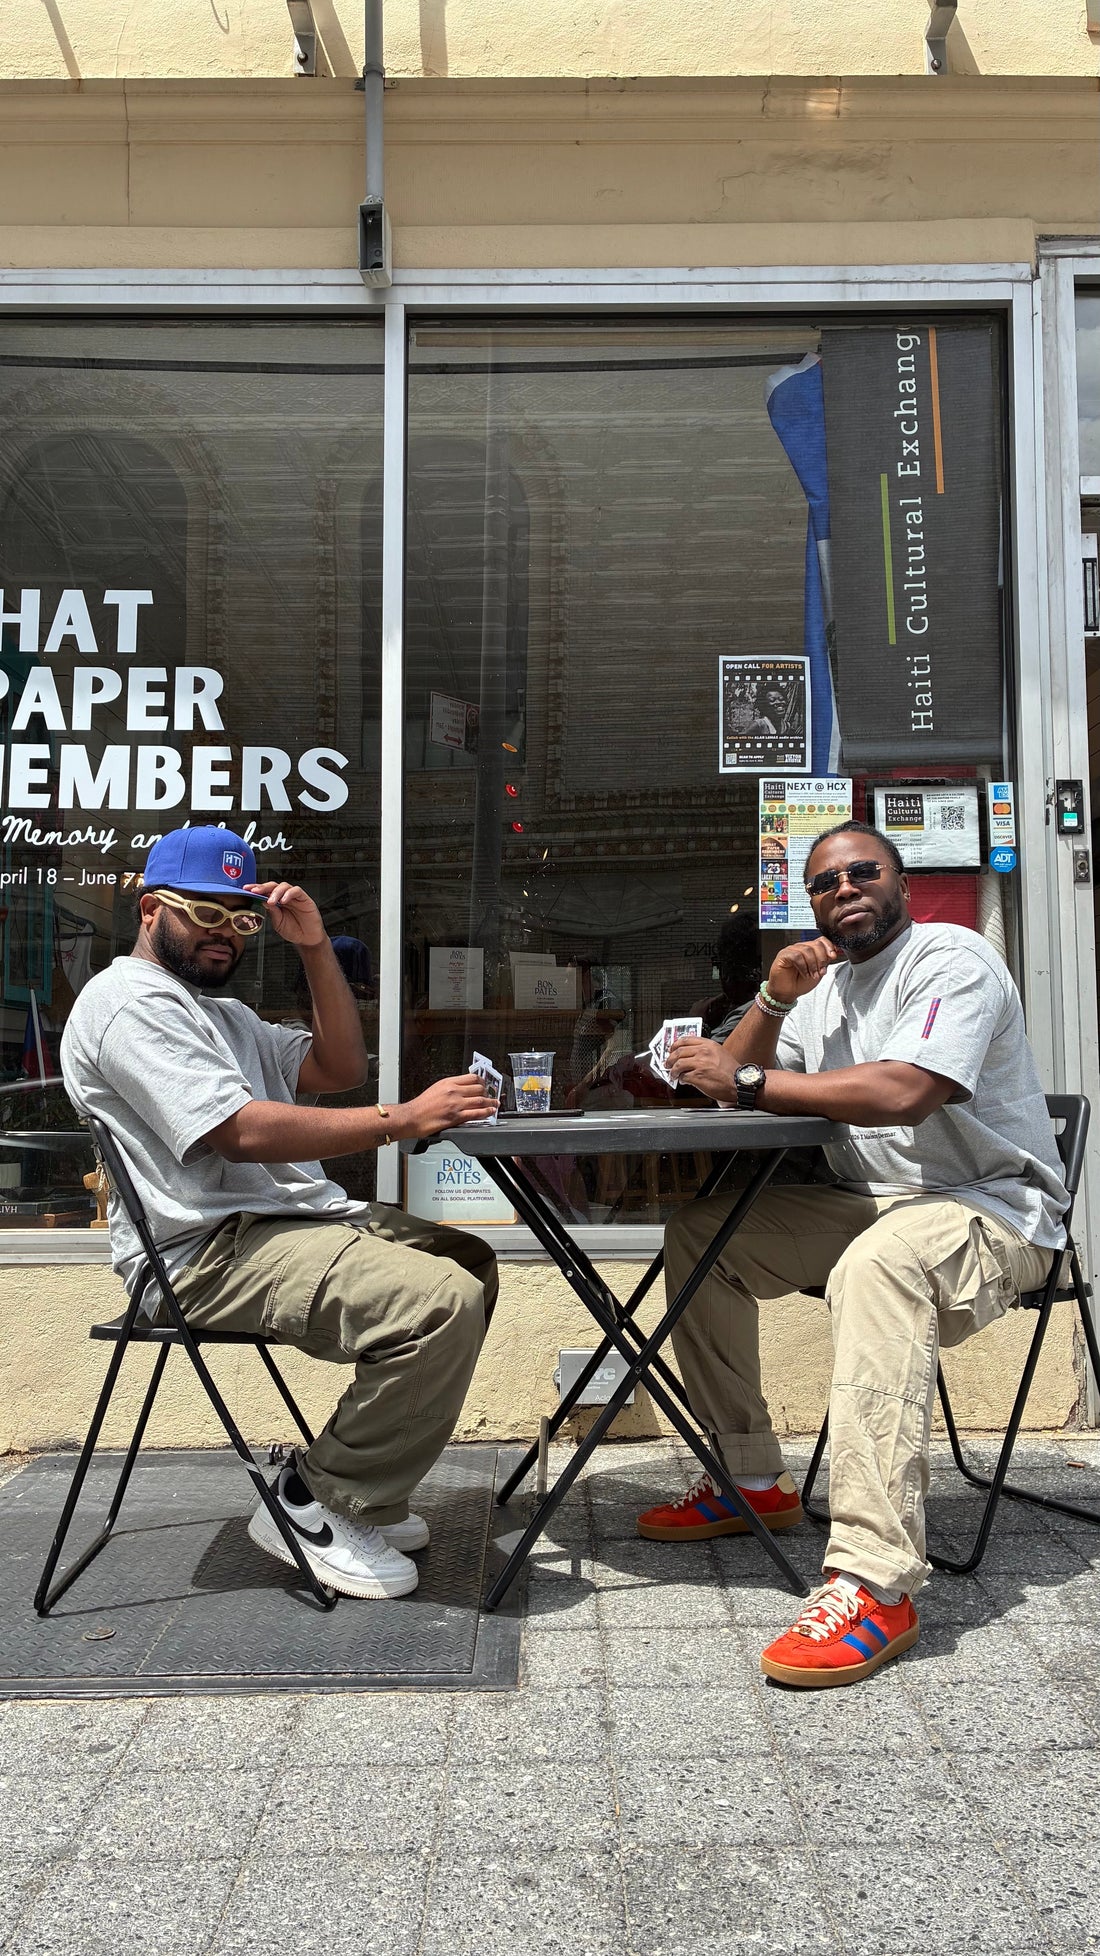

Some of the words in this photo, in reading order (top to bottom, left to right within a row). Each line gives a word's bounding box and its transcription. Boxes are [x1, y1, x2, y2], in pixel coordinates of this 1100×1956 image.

[894, 327, 921, 477] Exchang
[899, 497, 929, 635] Cultural
[0, 666, 225, 731] APER
[906, 654, 934, 731] Haiti
[0, 743, 349, 812] EMBERS
[787, 782, 812, 791] NEXT
[814, 783, 824, 791] @
[827, 782, 847, 791] HCX
[887, 796, 921, 808] Haiti
[2, 815, 118, 854] Memory
[225, 853, 242, 867] HTI
[994, 853, 1013, 863] ADT
[767, 863, 780, 874] 23
[36, 868, 58, 885] 18
[78, 868, 117, 887] June
[537, 979, 553, 988] BON
[442, 1158, 472, 1172] BON
